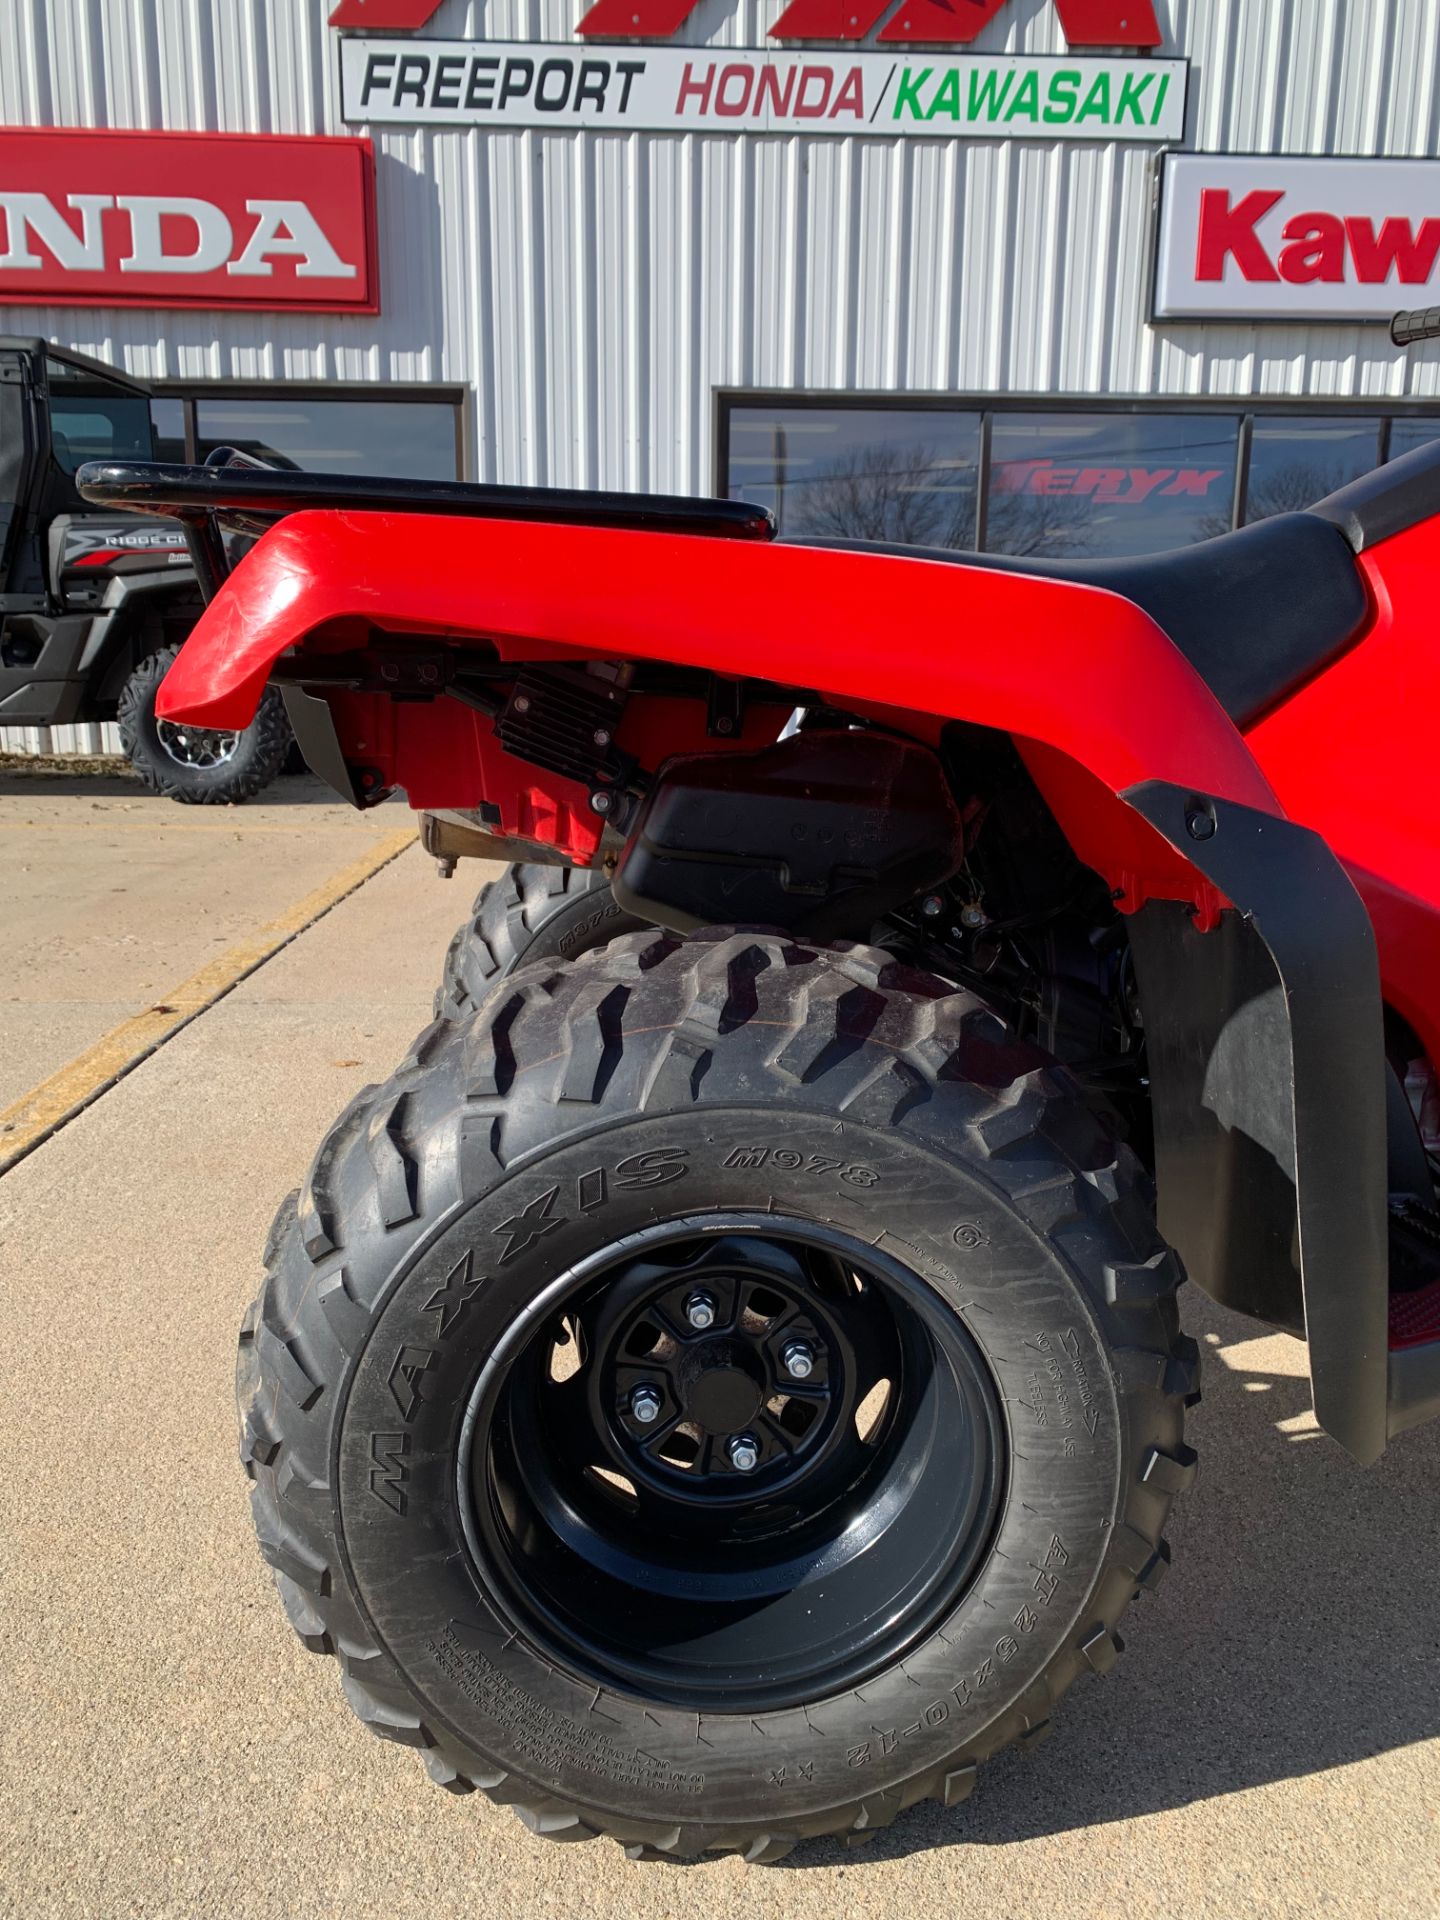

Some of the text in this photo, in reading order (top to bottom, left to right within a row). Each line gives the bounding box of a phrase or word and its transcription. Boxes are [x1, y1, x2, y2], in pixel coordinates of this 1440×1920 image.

[360, 53, 1170, 126] FREEPORT HONDA/KAWASAKI
[1195, 187, 1440, 285] Kaw
[991, 460, 1225, 504] TERYX
[105, 536, 161, 546] RIDGE
[721, 1146, 881, 1188] M978
[936, 1262, 965, 1291] TAIWAN
[370, 1146, 690, 1515] MAXXIS
[1025, 1372, 1048, 1425] TUBELESS
[1035, 1330, 1075, 1456] NOT FOR HIGHWAY USE
[1071, 1358, 1094, 1406] ROTATION
[483, 1674, 514, 1703] SHOULD
[489, 1695, 514, 1717] WHEN
[513, 1699, 552, 1728] PERSONS
[516, 1728, 550, 1751] MANUAL
[553, 1724, 588, 1746] TRAINED
[510, 1737, 563, 1774] WARNING
[585, 1751, 622, 1770] BEYOND
[667, 1772, 685, 1781] NOT
